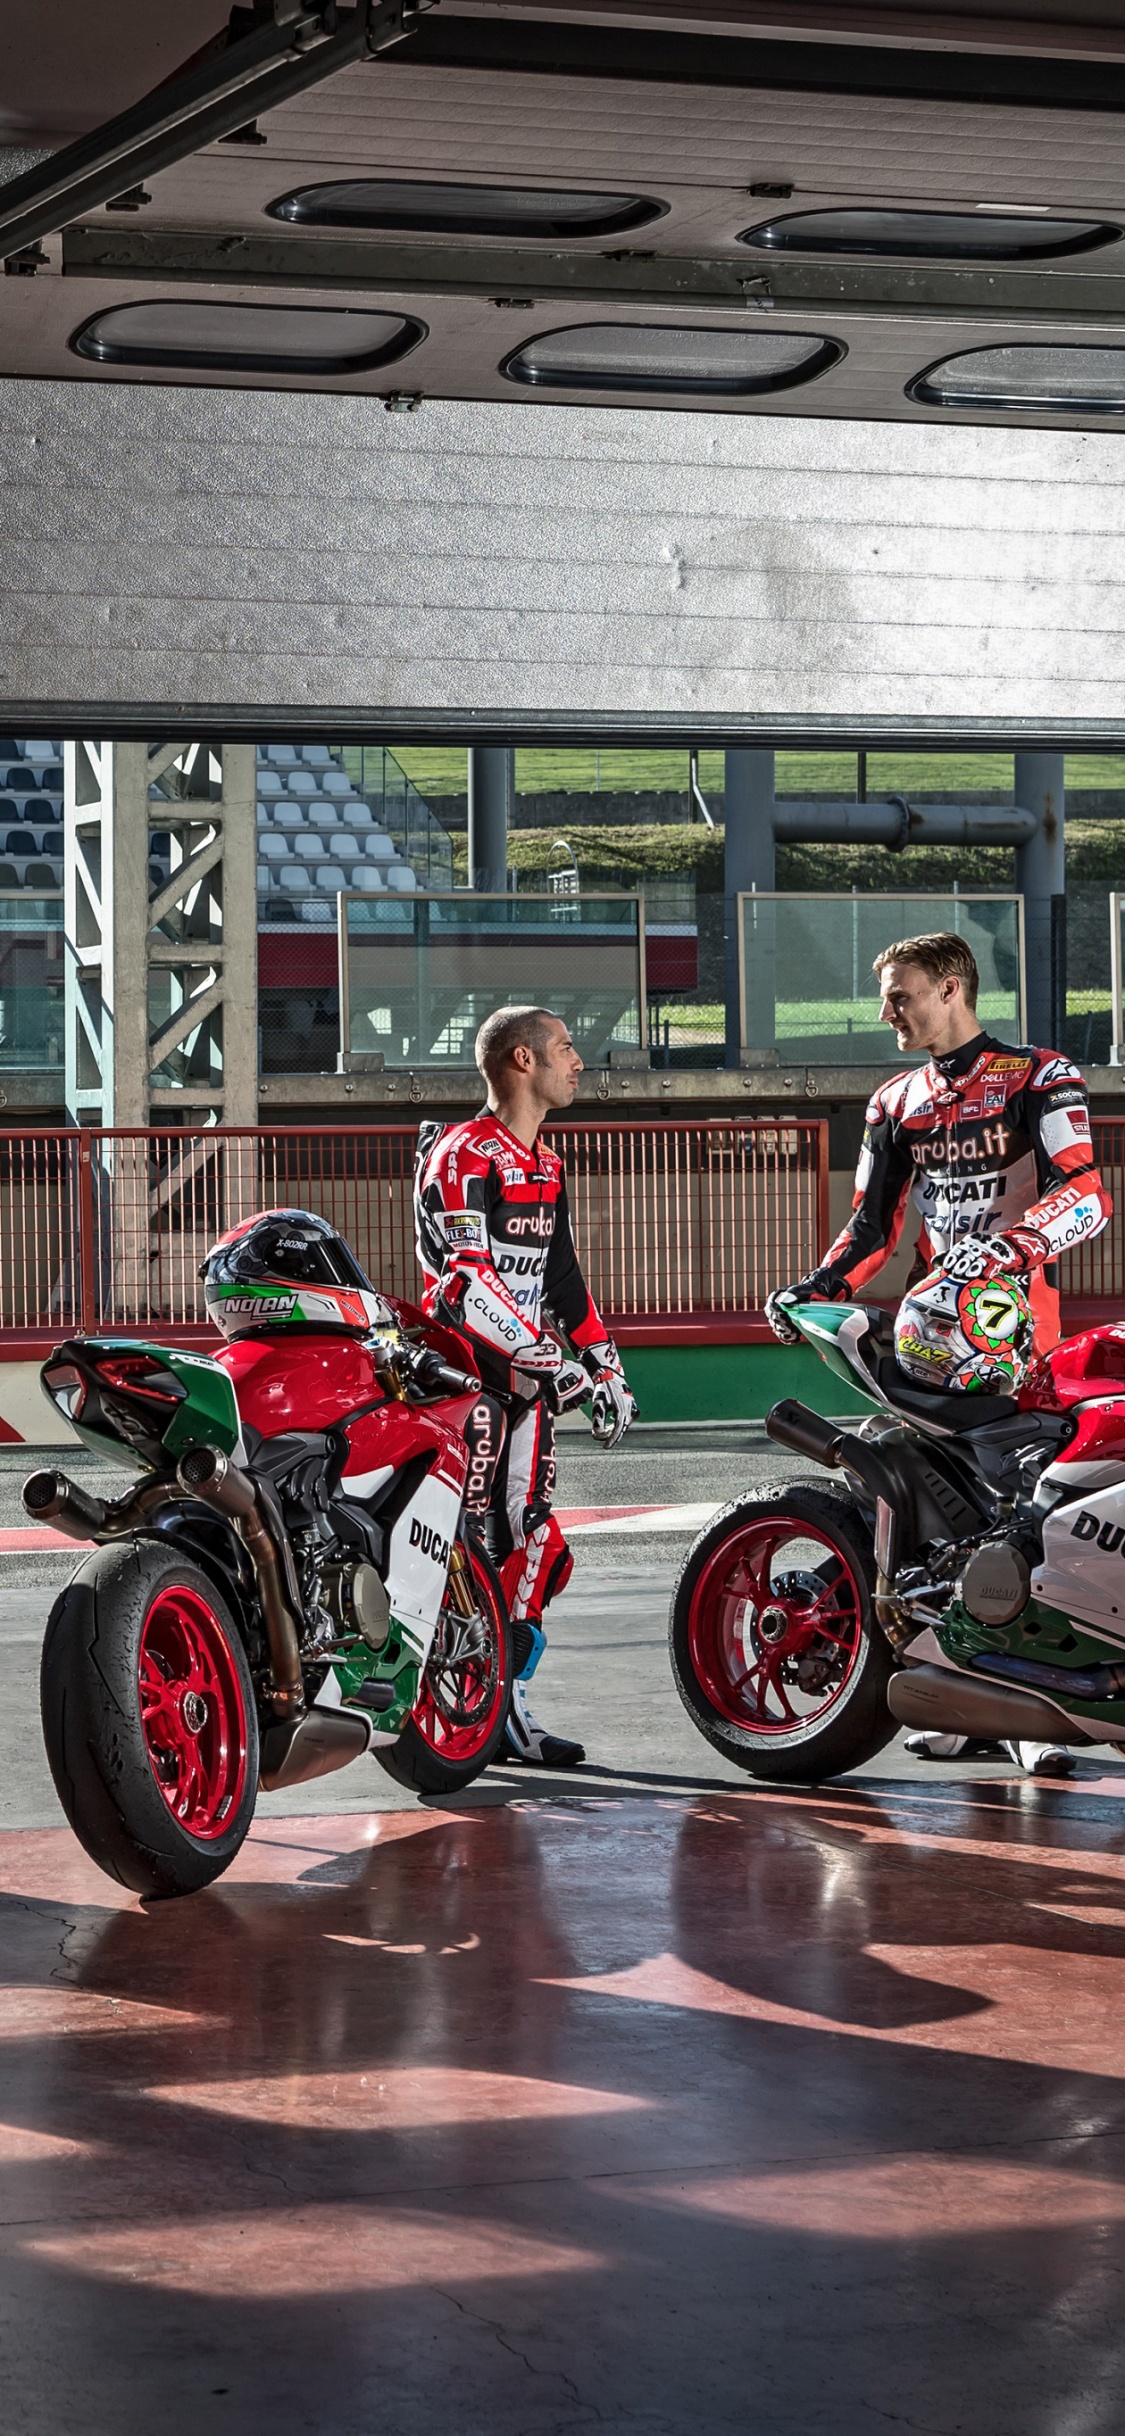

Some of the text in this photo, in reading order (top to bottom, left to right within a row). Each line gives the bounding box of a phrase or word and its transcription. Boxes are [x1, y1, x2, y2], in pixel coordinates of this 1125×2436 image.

[922, 1175, 1007, 1205] DUCATI
[1024, 1187, 1082, 1229] DUCATI
[225, 1294, 298, 1320] NOLAN
[481, 1269, 530, 1324] DUCATI
[978, 1298, 1015, 1331] 7
